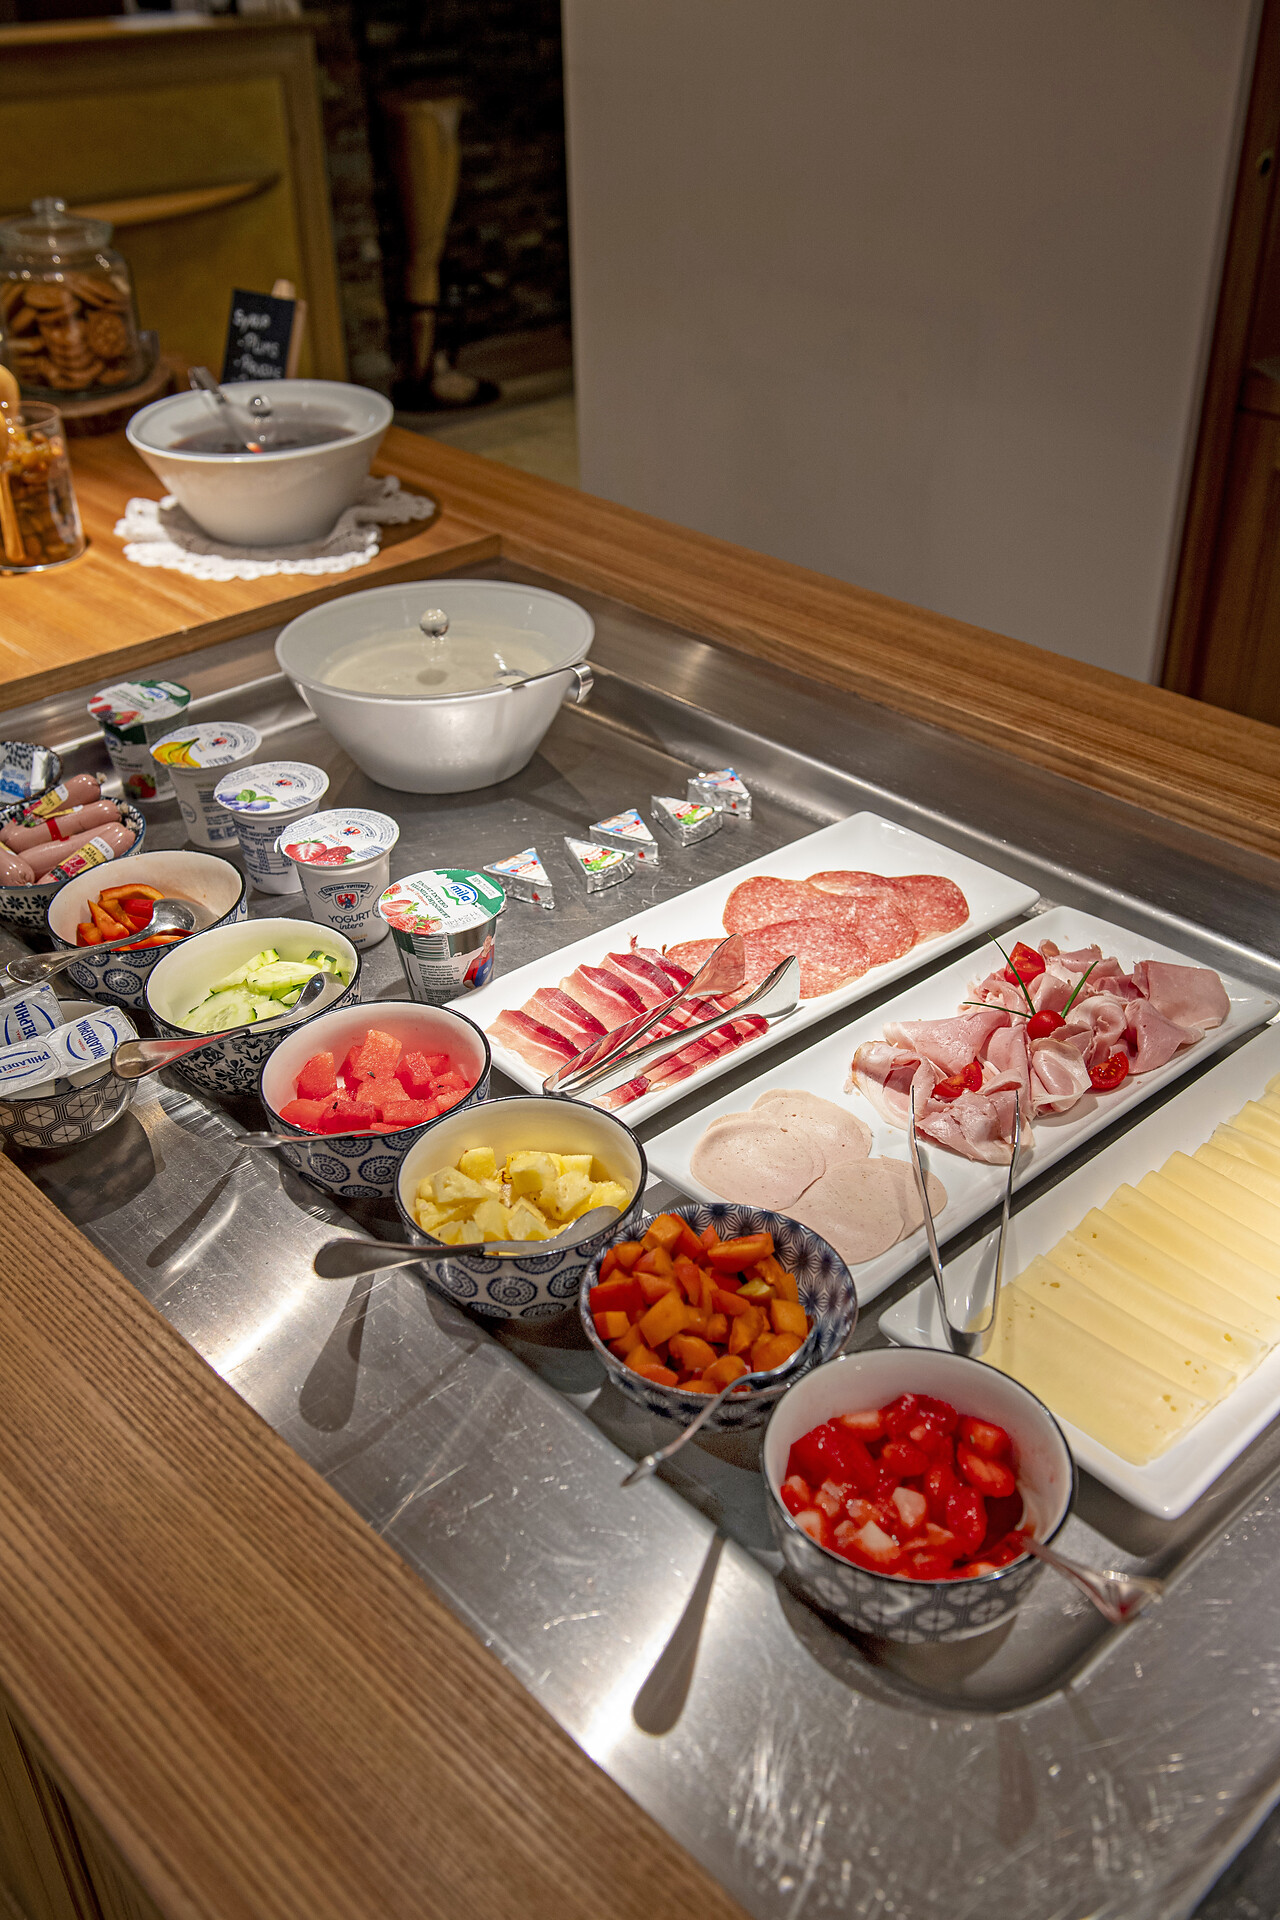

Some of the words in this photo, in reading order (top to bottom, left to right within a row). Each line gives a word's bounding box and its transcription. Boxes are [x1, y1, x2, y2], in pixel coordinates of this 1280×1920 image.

[450, 885, 471, 902] mila
[328, 909, 371, 924] YOGURT
[339, 922, 364, 930] intero
[13, 1000, 39, 1040] DELPHIA
[75, 1019, 109, 1060] PHILADELPHIA
